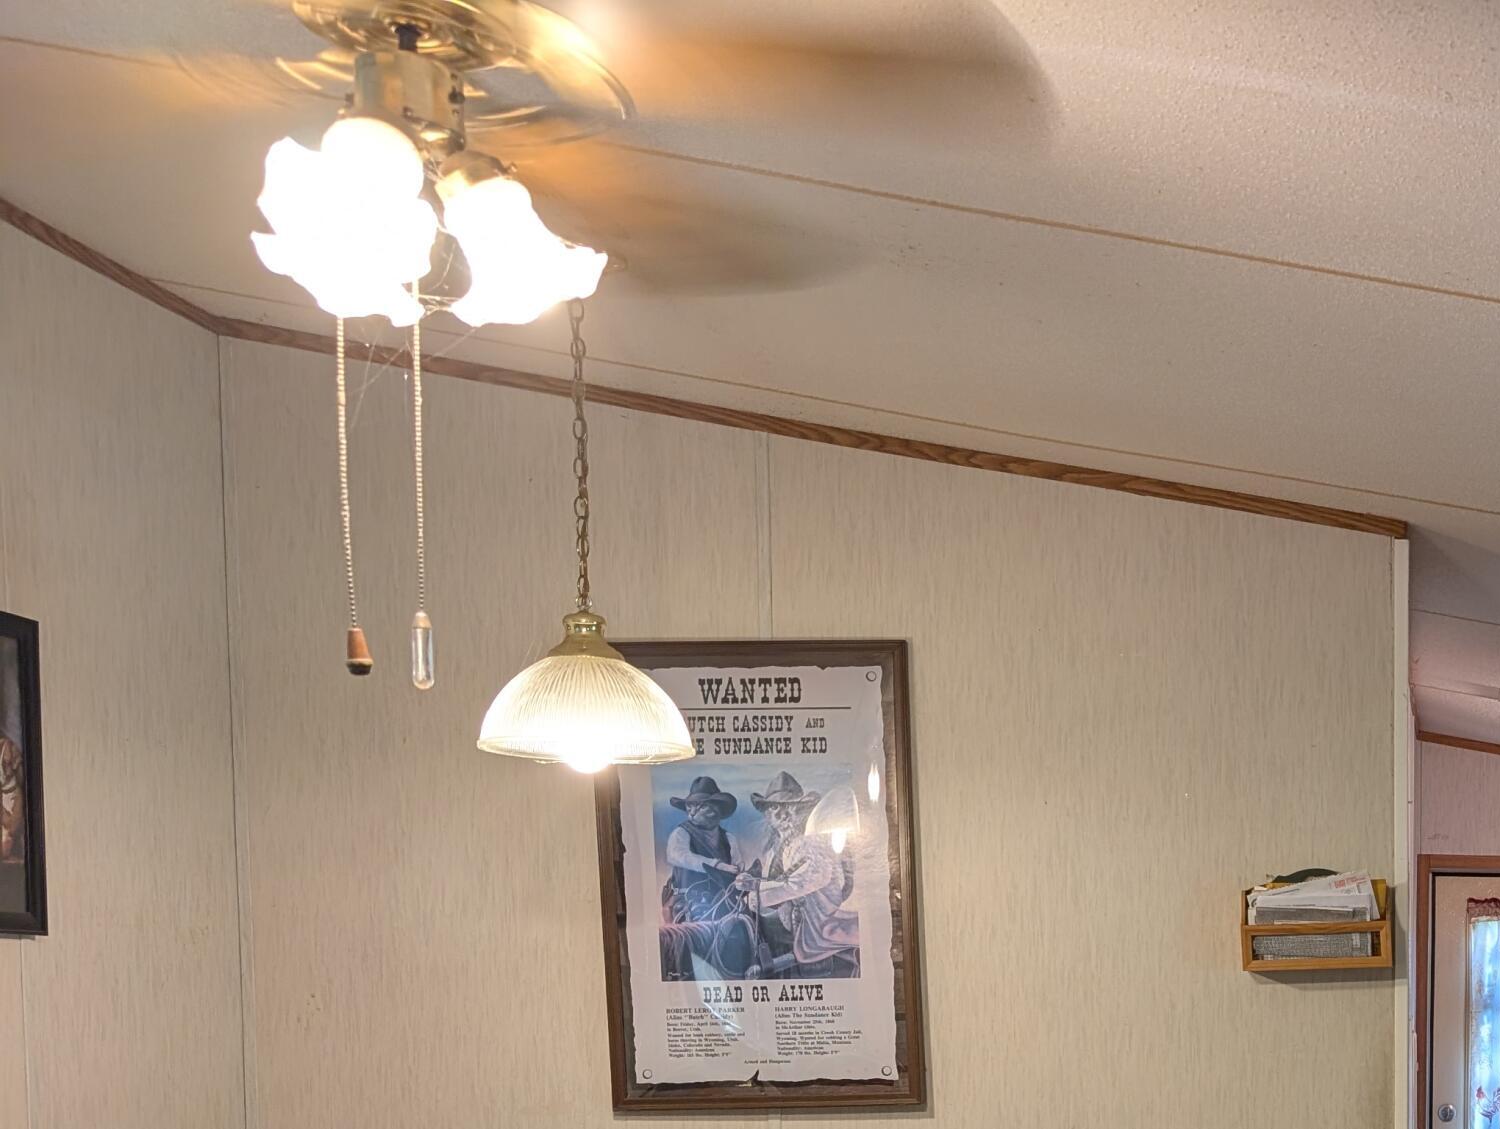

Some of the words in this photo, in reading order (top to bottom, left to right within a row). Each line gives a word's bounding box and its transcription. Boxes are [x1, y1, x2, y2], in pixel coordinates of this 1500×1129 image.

[699, 677, 802, 705] WANTED
[687, 715, 726, 733] UTCH
[732, 714, 794, 733] CASSIDY
[806, 718, 825, 729] AND
[714, 736, 792, 755] SUNDANCE
[800, 736, 827, 754] KID
[703, 985, 743, 1003] DEAD
[752, 985, 770, 1002] OR
[778, 984, 824, 1001] ALIVE
